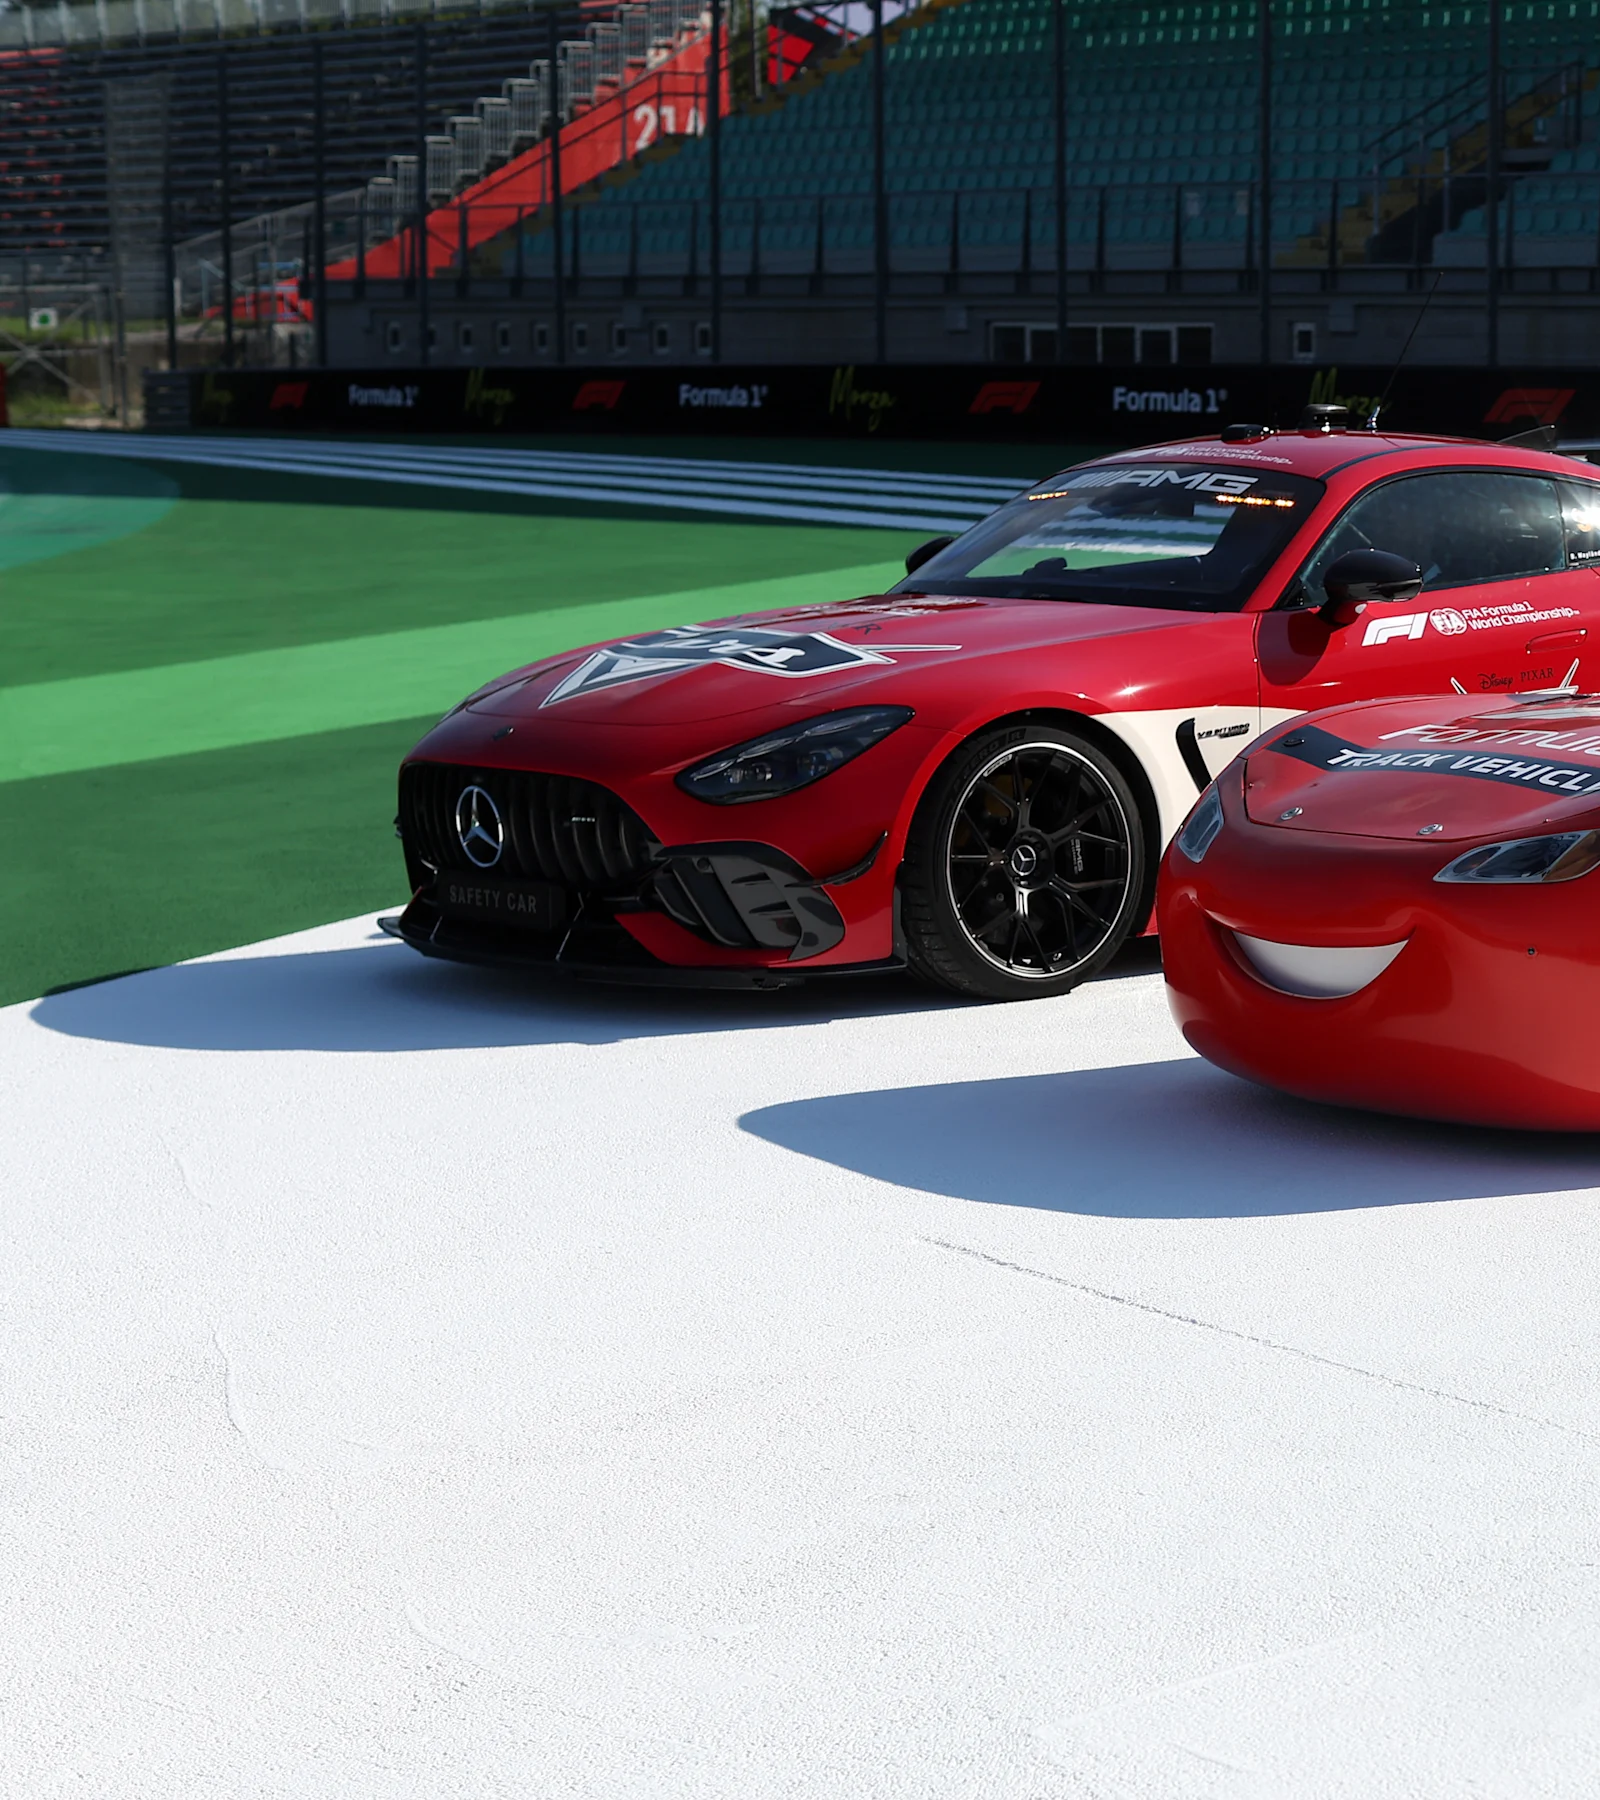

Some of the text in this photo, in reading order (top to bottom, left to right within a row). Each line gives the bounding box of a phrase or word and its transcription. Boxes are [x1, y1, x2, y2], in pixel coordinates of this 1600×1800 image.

[347, 383, 405, 408] Formula
[678, 384, 751, 408] Formula
[1111, 386, 1204, 413] Formula
[1103, 469, 1259, 495] AMG
[1462, 605, 1484, 620] FIA
[1483, 601, 1524, 617] Formula
[1467, 617, 1502, 631] World
[1478, 672, 1514, 691] Disney
[1519, 667, 1555, 683] PIXAR
[1326, 748, 1445, 768] TRACK
[448, 884, 538, 914] SAFETY CAR
